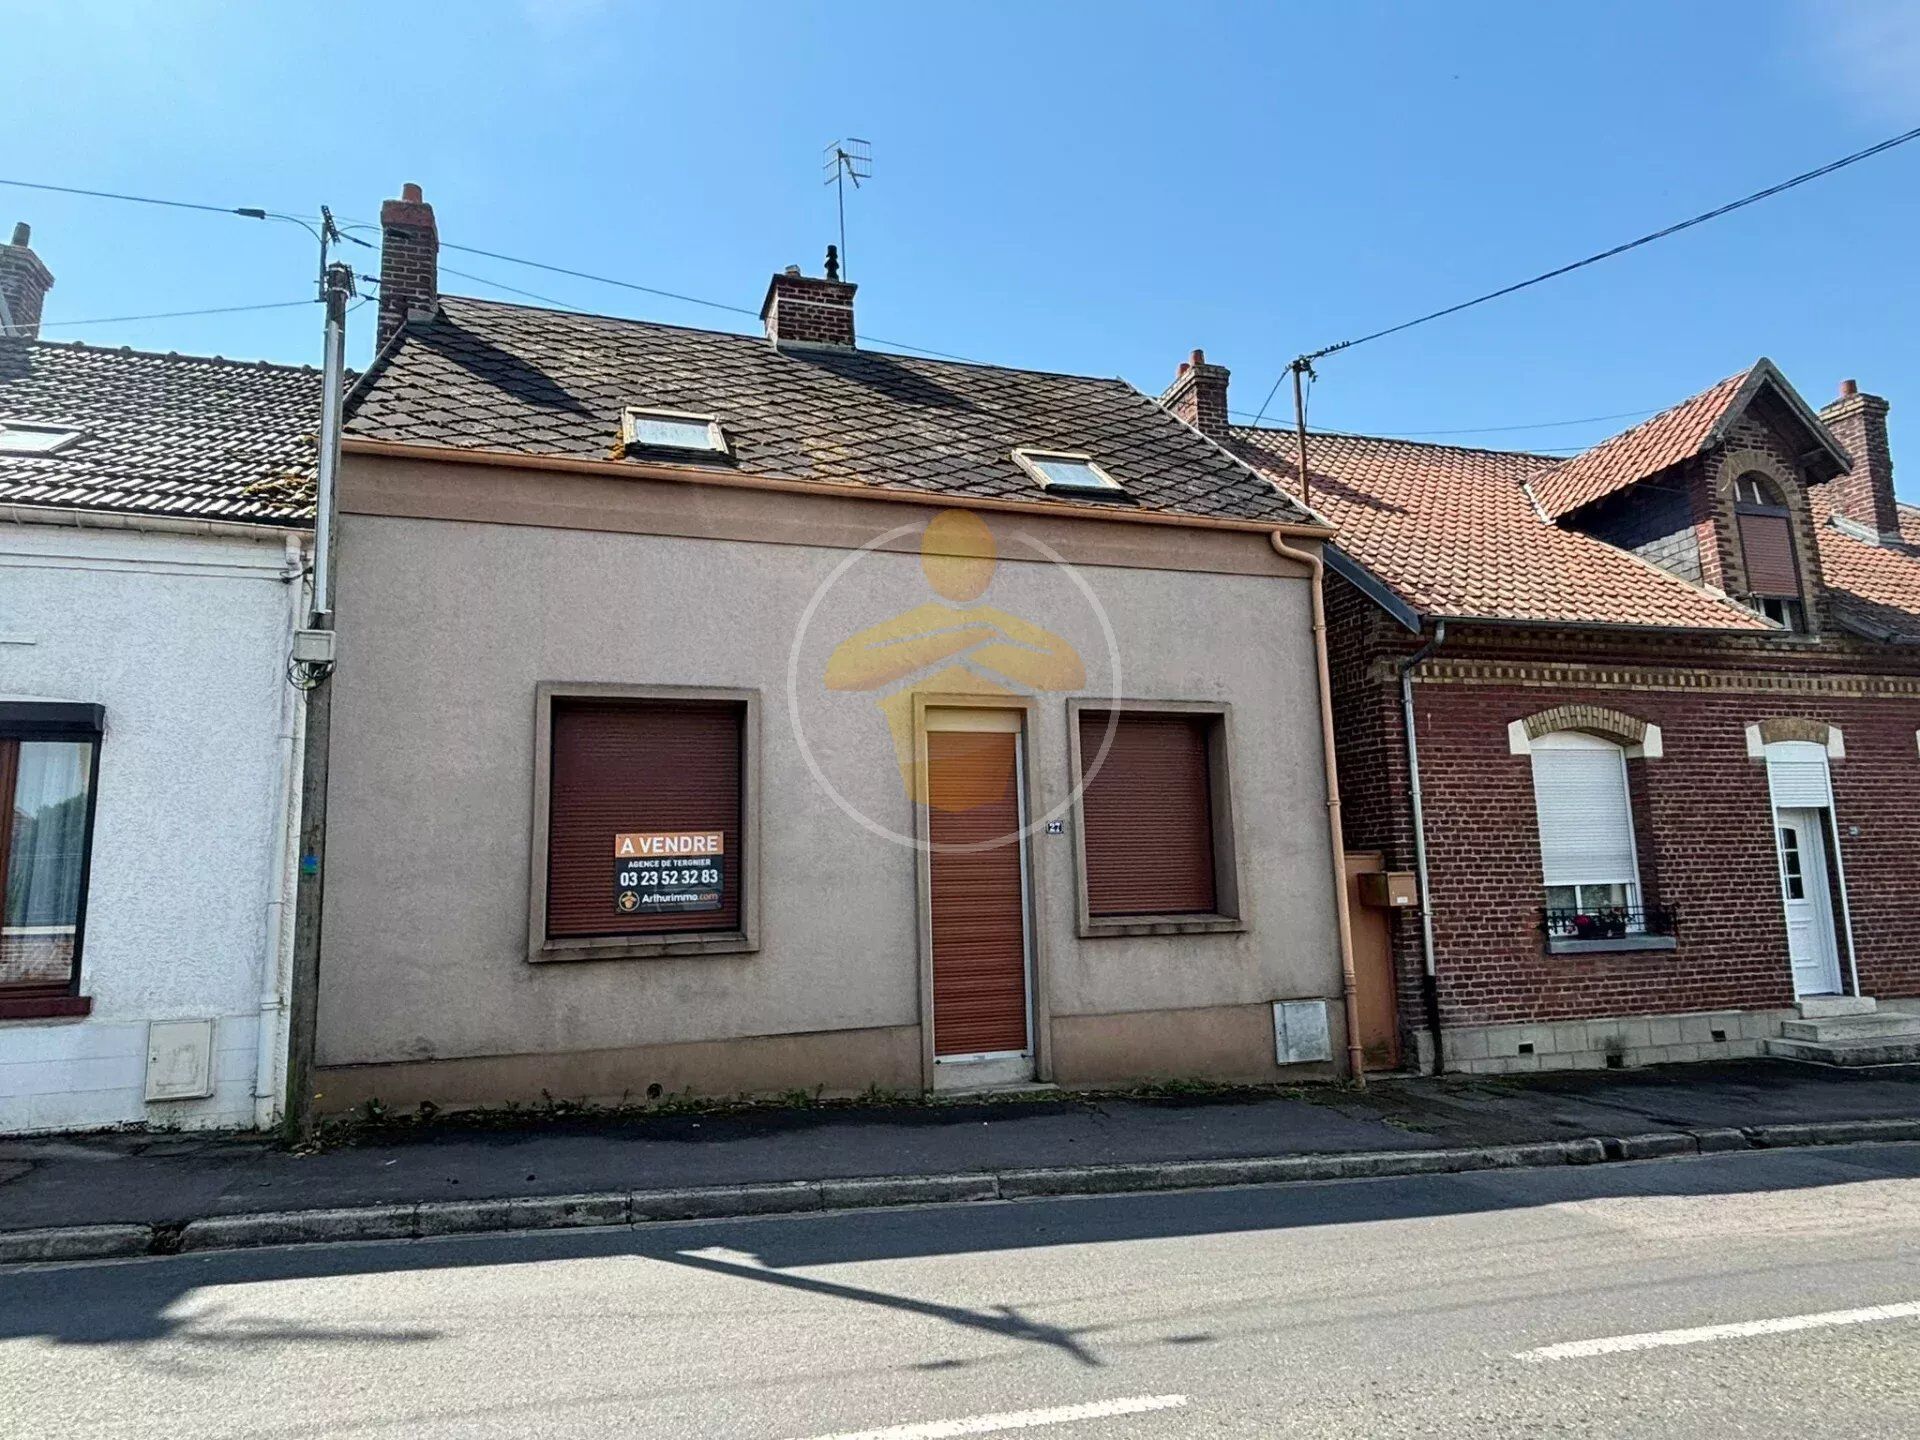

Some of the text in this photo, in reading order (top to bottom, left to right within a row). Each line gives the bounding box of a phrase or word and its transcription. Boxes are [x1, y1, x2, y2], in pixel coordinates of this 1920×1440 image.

[1049, 822, 1061, 832] 27
[620, 835, 718, 854] A VENDRE
[628, 860, 659, 868] AGENCE
[673, 859, 711, 867] TERGNIER
[620, 869, 718, 886] 03 23 52 32 83
[641, 892, 718, 903] Arthurimmo.com
